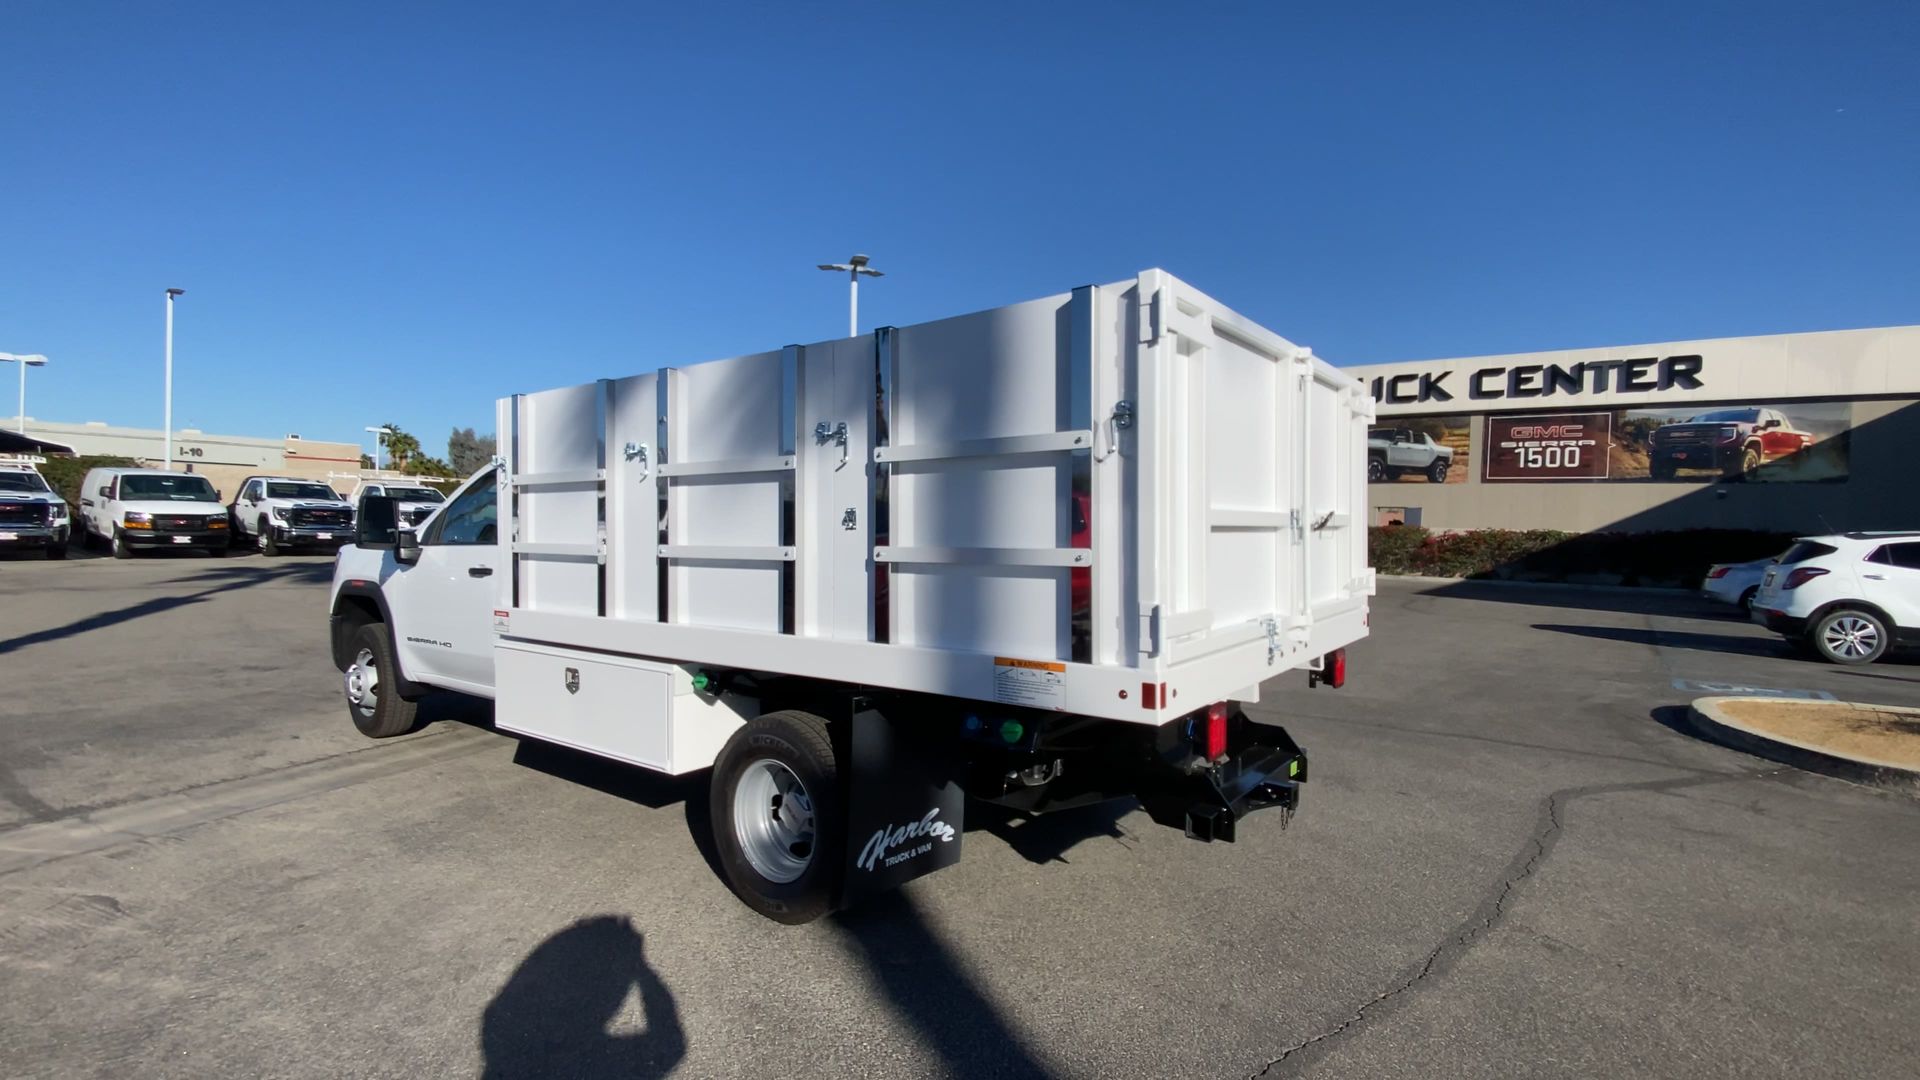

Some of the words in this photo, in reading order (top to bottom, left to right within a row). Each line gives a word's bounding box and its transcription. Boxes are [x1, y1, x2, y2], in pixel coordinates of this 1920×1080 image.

[1469, 355, 1704, 400] CENTER
[1511, 425, 1583, 438] GMC
[179, 446, 203, 457] I-10
[1501, 440, 1596, 448] SIERRA
[1514, 447, 1580, 468] 1500
[406, 636, 438, 645] SIERRA
[857, 807, 955, 872] Harbor
[885, 849, 910, 867] TRUCK
[917, 842, 932, 855] VAN
